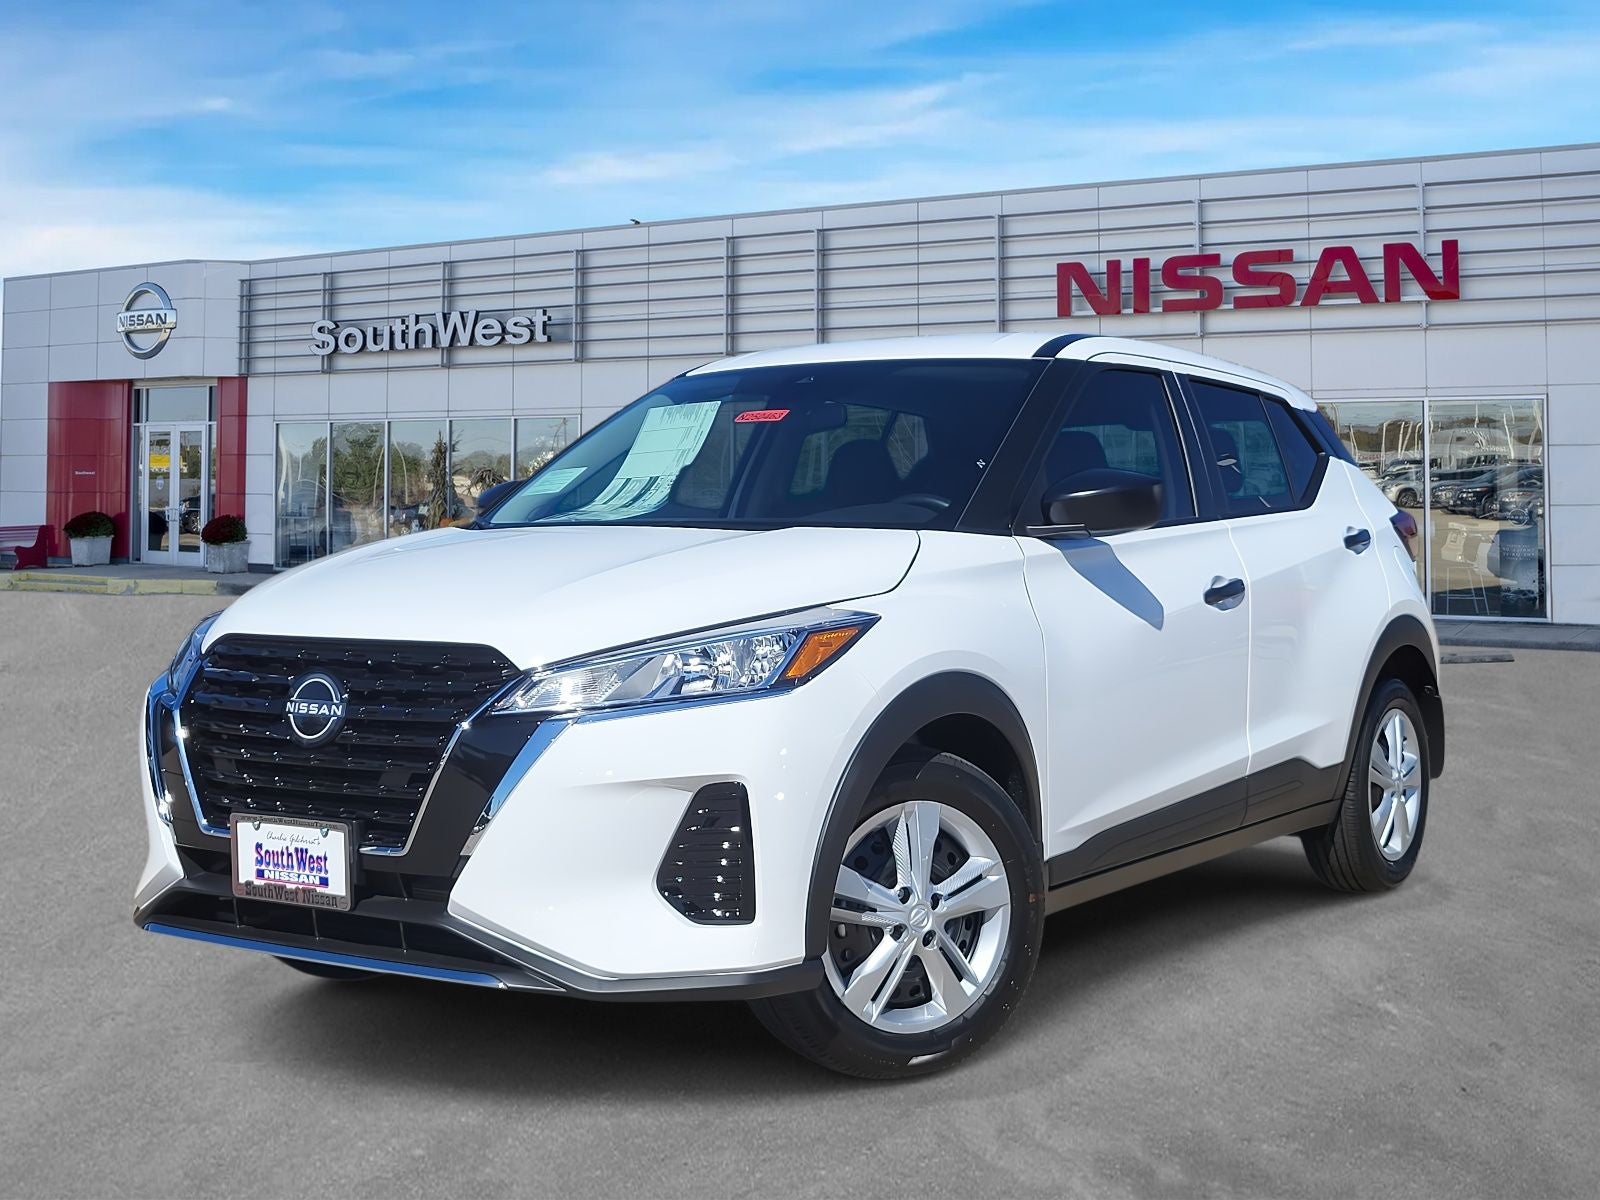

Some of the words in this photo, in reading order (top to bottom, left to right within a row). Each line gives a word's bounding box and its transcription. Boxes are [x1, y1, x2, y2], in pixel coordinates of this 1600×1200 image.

[1056, 239, 1461, 318] NISSAN
[118, 312, 168, 328] NISSAN
[308, 308, 552, 357] SouthWest
[285, 702, 343, 715] NISSAN
[255, 842, 328, 875] SouthWest
[264, 868, 319, 885] NISSAN
[245, 881, 299, 903] SouthWest
[302, 887, 338, 907] Nissan
